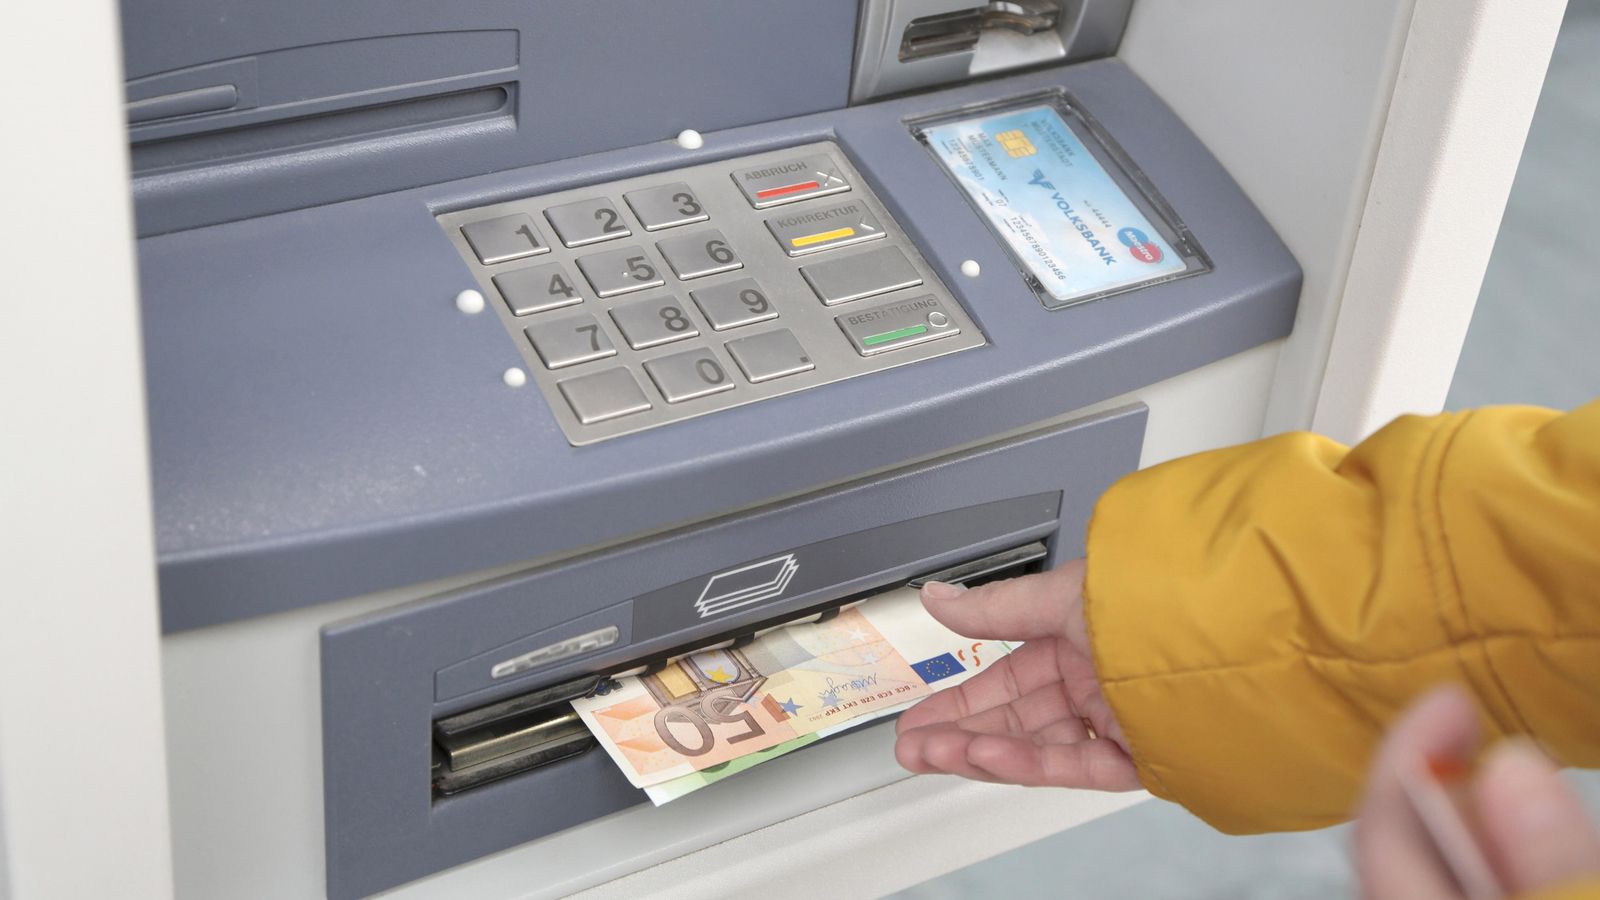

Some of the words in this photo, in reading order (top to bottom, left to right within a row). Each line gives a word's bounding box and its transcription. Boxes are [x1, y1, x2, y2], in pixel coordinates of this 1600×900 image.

[744, 161, 807, 180] ABBRUCH
[672, 192, 702, 216] 3
[778, 205, 859, 228] KORREKTUR
[594, 208, 625, 233] 2
[1050, 191, 1117, 266] VOLKSBANK
[514, 224, 539, 247] 1
[1009, 216, 1067, 280] 1234567890123456
[1124, 230, 1155, 261] Maestro
[705, 240, 734, 264] 6
[626, 256, 655, 281] 5
[548, 273, 574, 298] 4
[739, 289, 769, 314] 9
[659, 306, 690, 332] 8
[575, 324, 601, 351] 7
[695, 358, 725, 385] 0
[860, 695, 876, 704] EZB
[878, 690, 894, 699] ECB
[896, 685, 911, 694] BCE
[825, 706, 841, 717] EKP
[843, 701, 859, 710] EKT
[653, 689, 766, 757] 50
